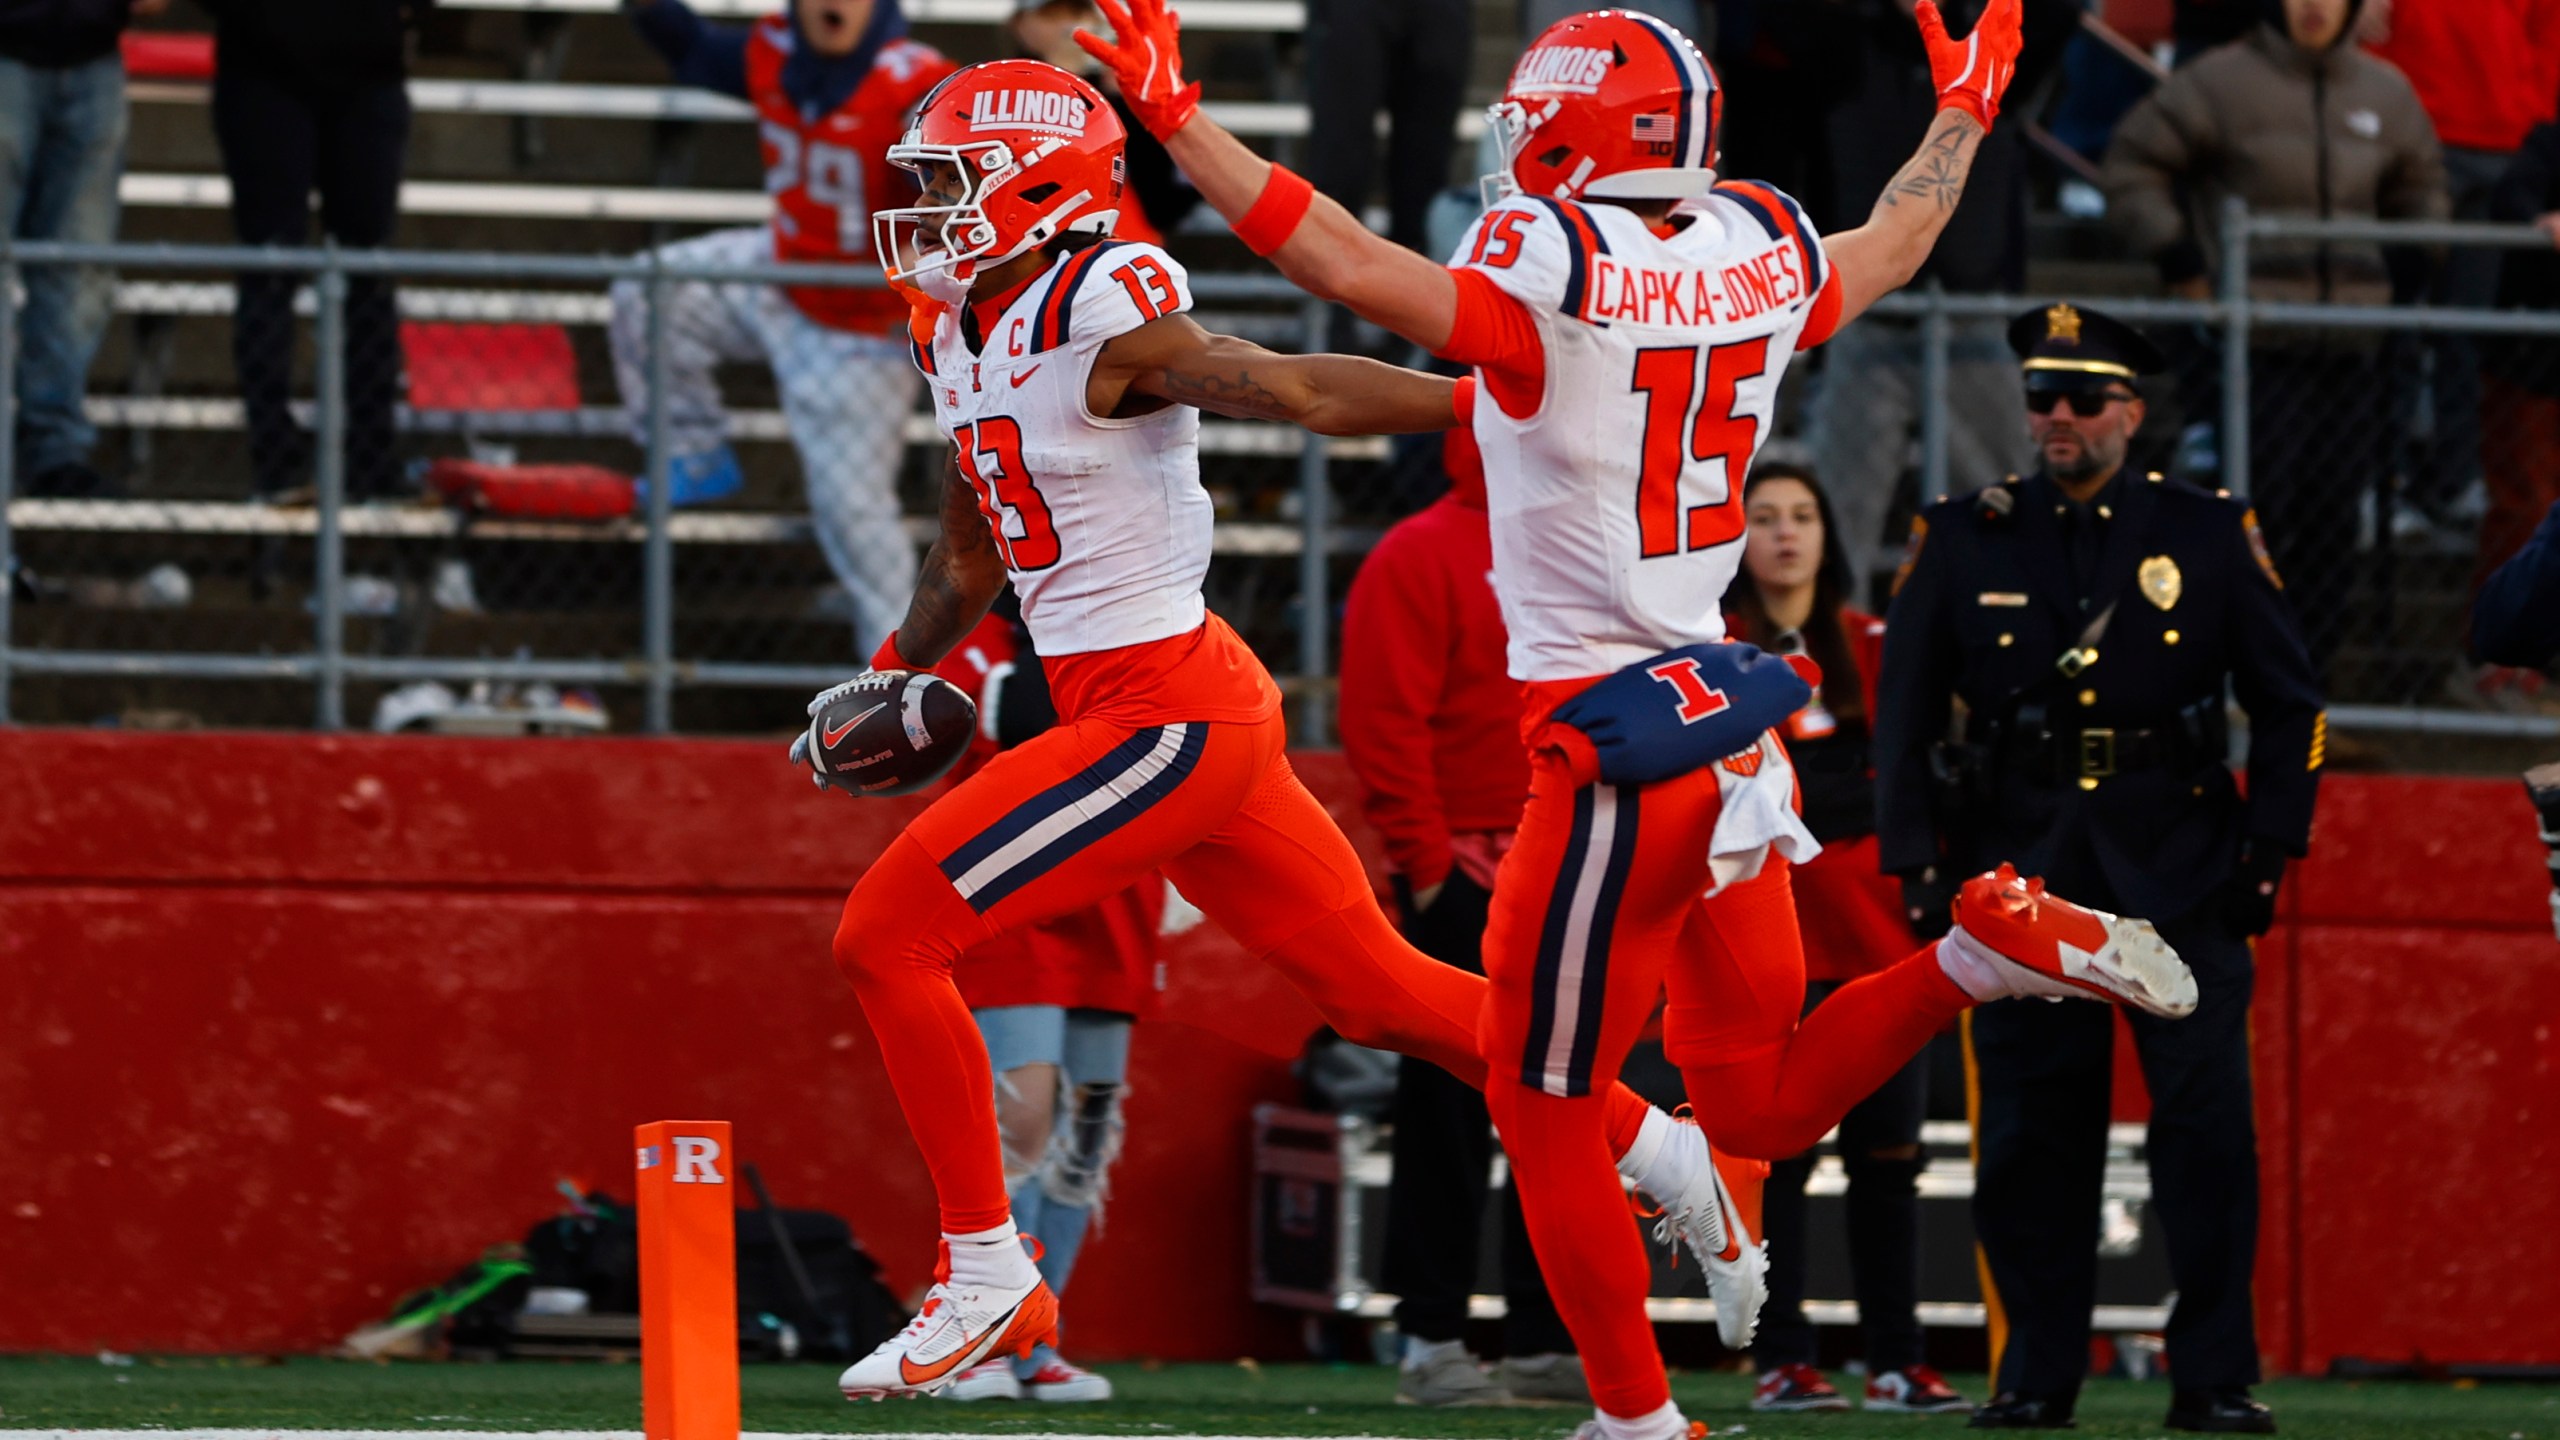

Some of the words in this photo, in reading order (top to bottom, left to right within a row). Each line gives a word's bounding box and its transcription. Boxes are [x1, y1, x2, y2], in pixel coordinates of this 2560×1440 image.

[1512, 45, 1615, 85] LLINOIS
[972, 88, 1087, 130] ILLINOIS
[1468, 209, 1537, 269] 15
[1109, 253, 1182, 323] 13
[1594, 243, 1800, 327] CAPKA-JONES
[1008, 317, 1025, 357] C
[1630, 332, 1775, 561] 15
[953, 414, 1062, 572] 13
[1645, 656, 1731, 726] I
[671, 1135, 726, 1185] R
